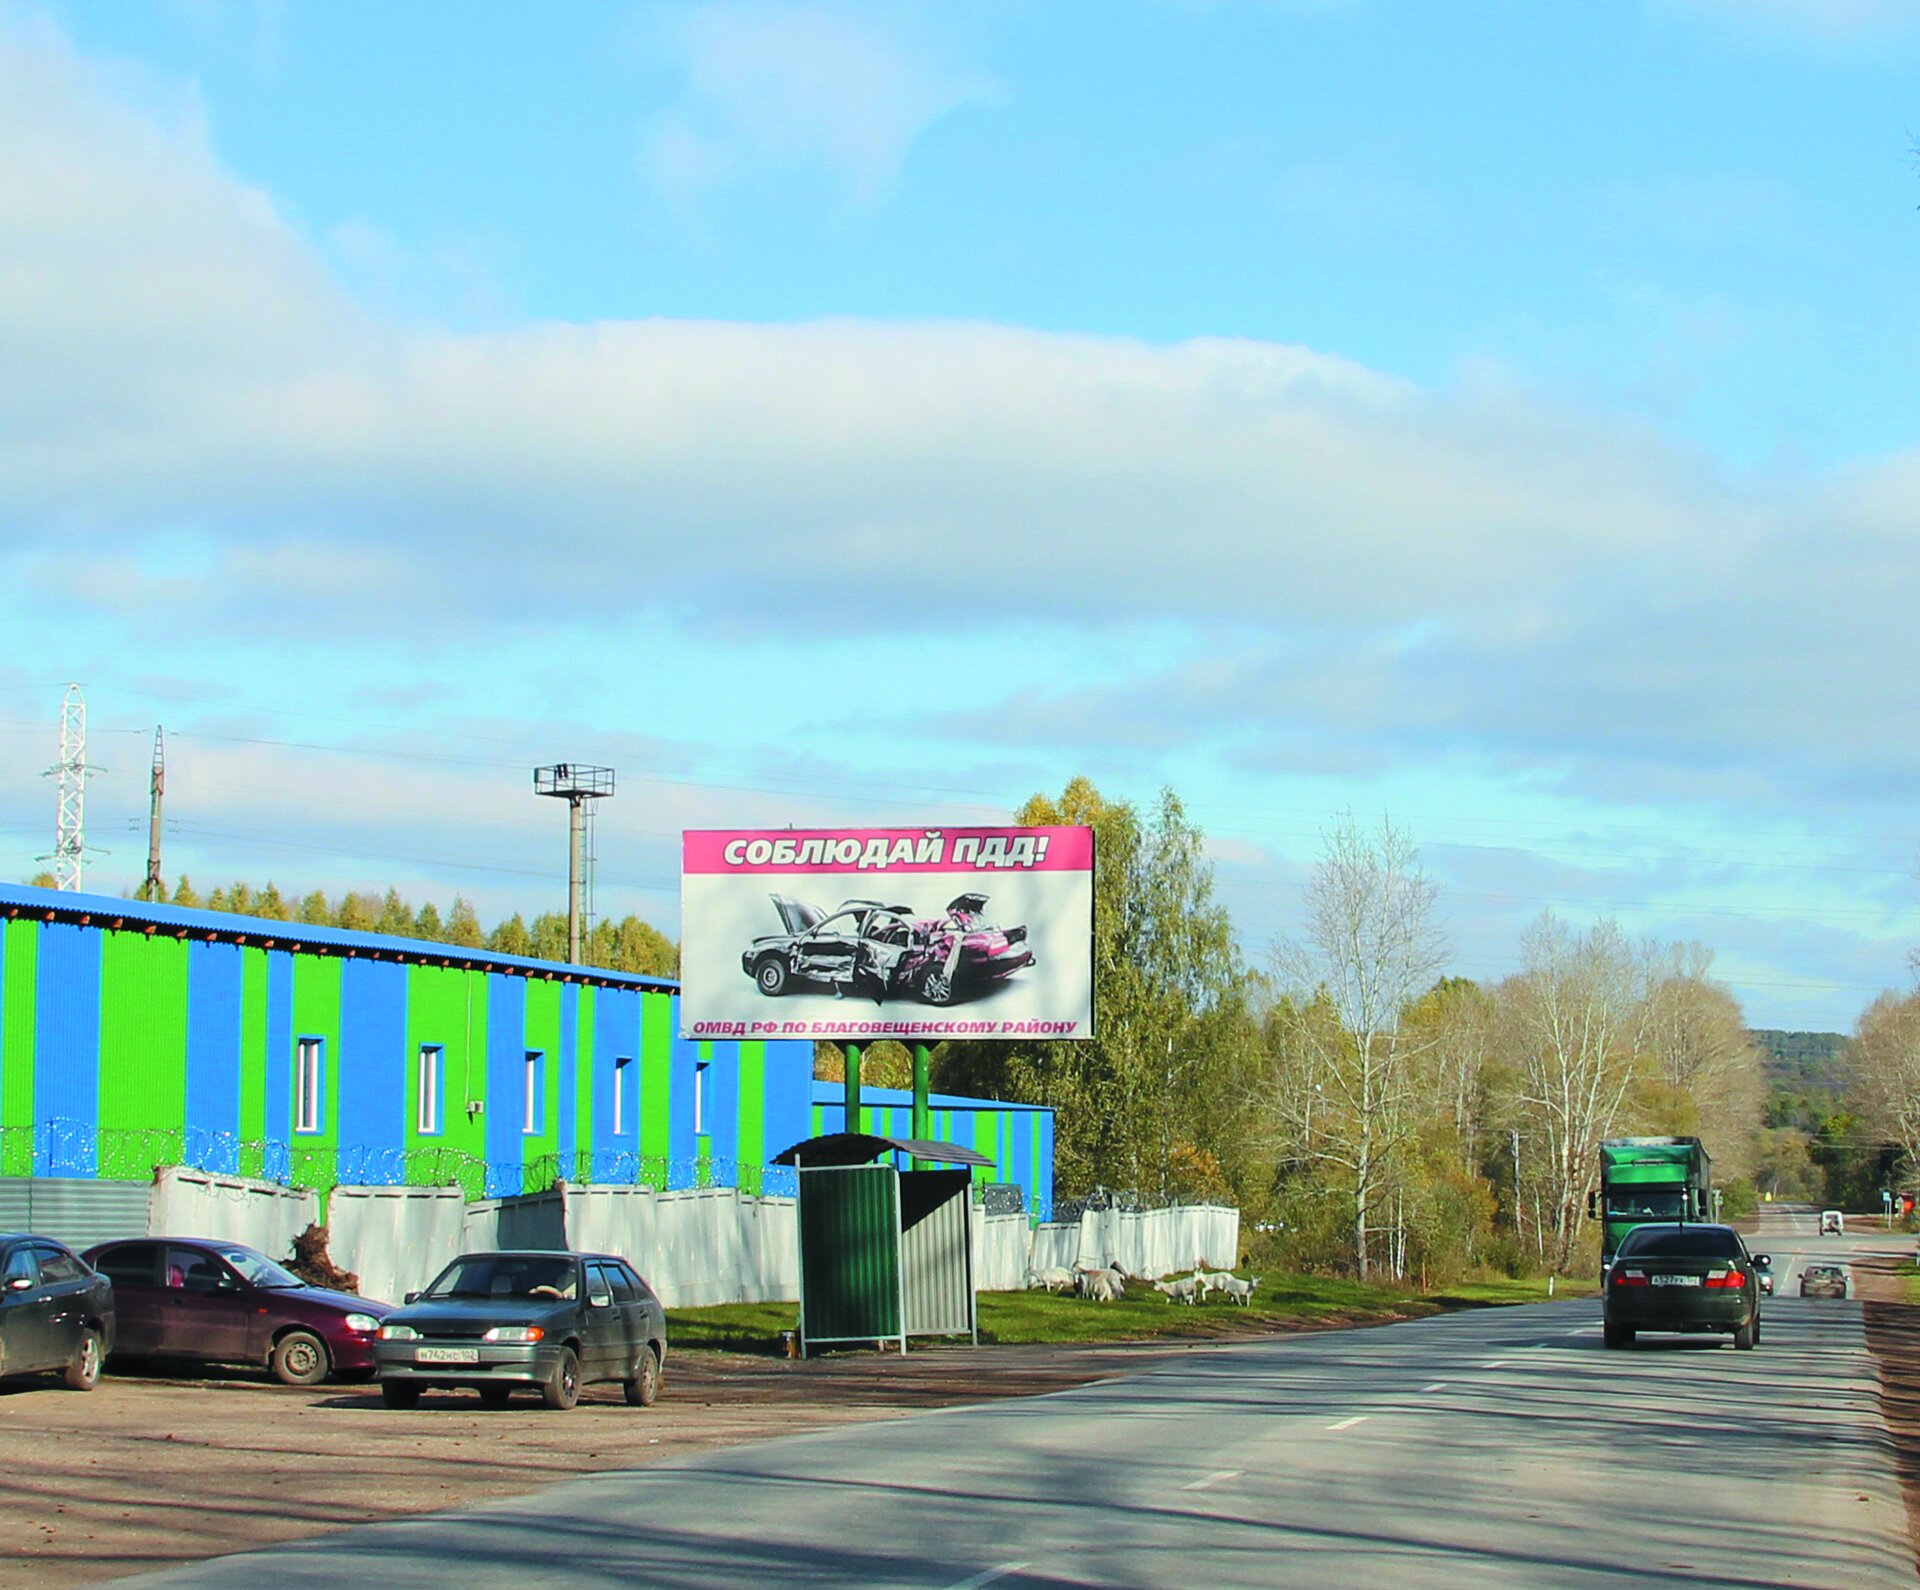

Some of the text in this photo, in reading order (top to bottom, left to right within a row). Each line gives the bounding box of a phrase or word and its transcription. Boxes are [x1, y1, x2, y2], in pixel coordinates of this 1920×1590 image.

[723, 830, 1050, 869] СОБЛЮДАЙ ПДД!
[693, 1018, 1078, 1035] ОМВД РФ ПО БЛАГОВЕЩЕНСКОМУ РАЙОНУ
